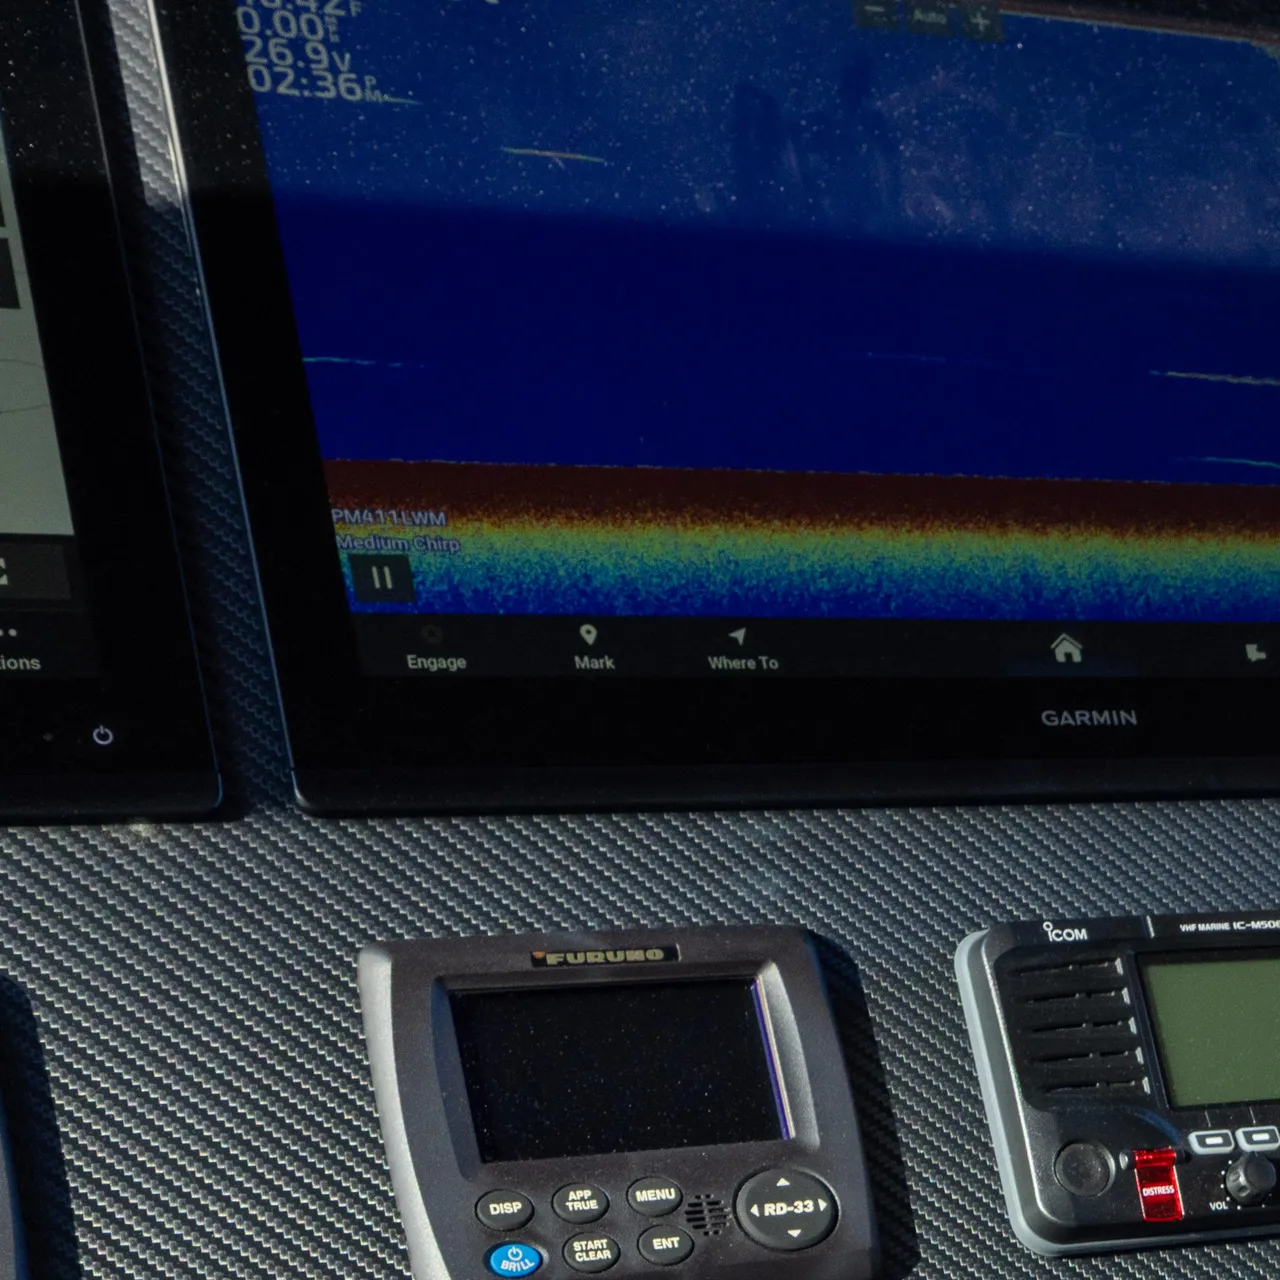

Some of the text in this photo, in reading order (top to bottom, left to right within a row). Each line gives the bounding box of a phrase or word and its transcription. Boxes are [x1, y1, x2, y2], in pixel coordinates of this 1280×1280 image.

[331, 508, 448, 526] PM411LWM
[336, 534, 460, 552] Medium Chirp
[406, 654, 467, 671] Engage
[574, 655, 616, 669] Mark
[708, 656, 779, 670] Where To
[1041, 709, 1137, 727] GARMIN
[1179, 923, 1197, 932] VHF
[1198, 921, 1231, 931] MARINE
[545, 948, 665, 965] FURUNO
[568, 1189, 592, 1201] APP
[636, 1188, 677, 1202] MENU
[1142, 1184, 1175, 1197] DISTRESS
[489, 1201, 523, 1216] DISP
[565, 1198, 599, 1212] TRUE
[763, 1199, 815, 1216] RD-33
[1209, 1201, 1229, 1211] VOL
[573, 1238, 608, 1252] START
[652, 1236, 681, 1251] ENT
[575, 1248, 612, 1262] CLEAR
[500, 1257, 536, 1273] BRILL
